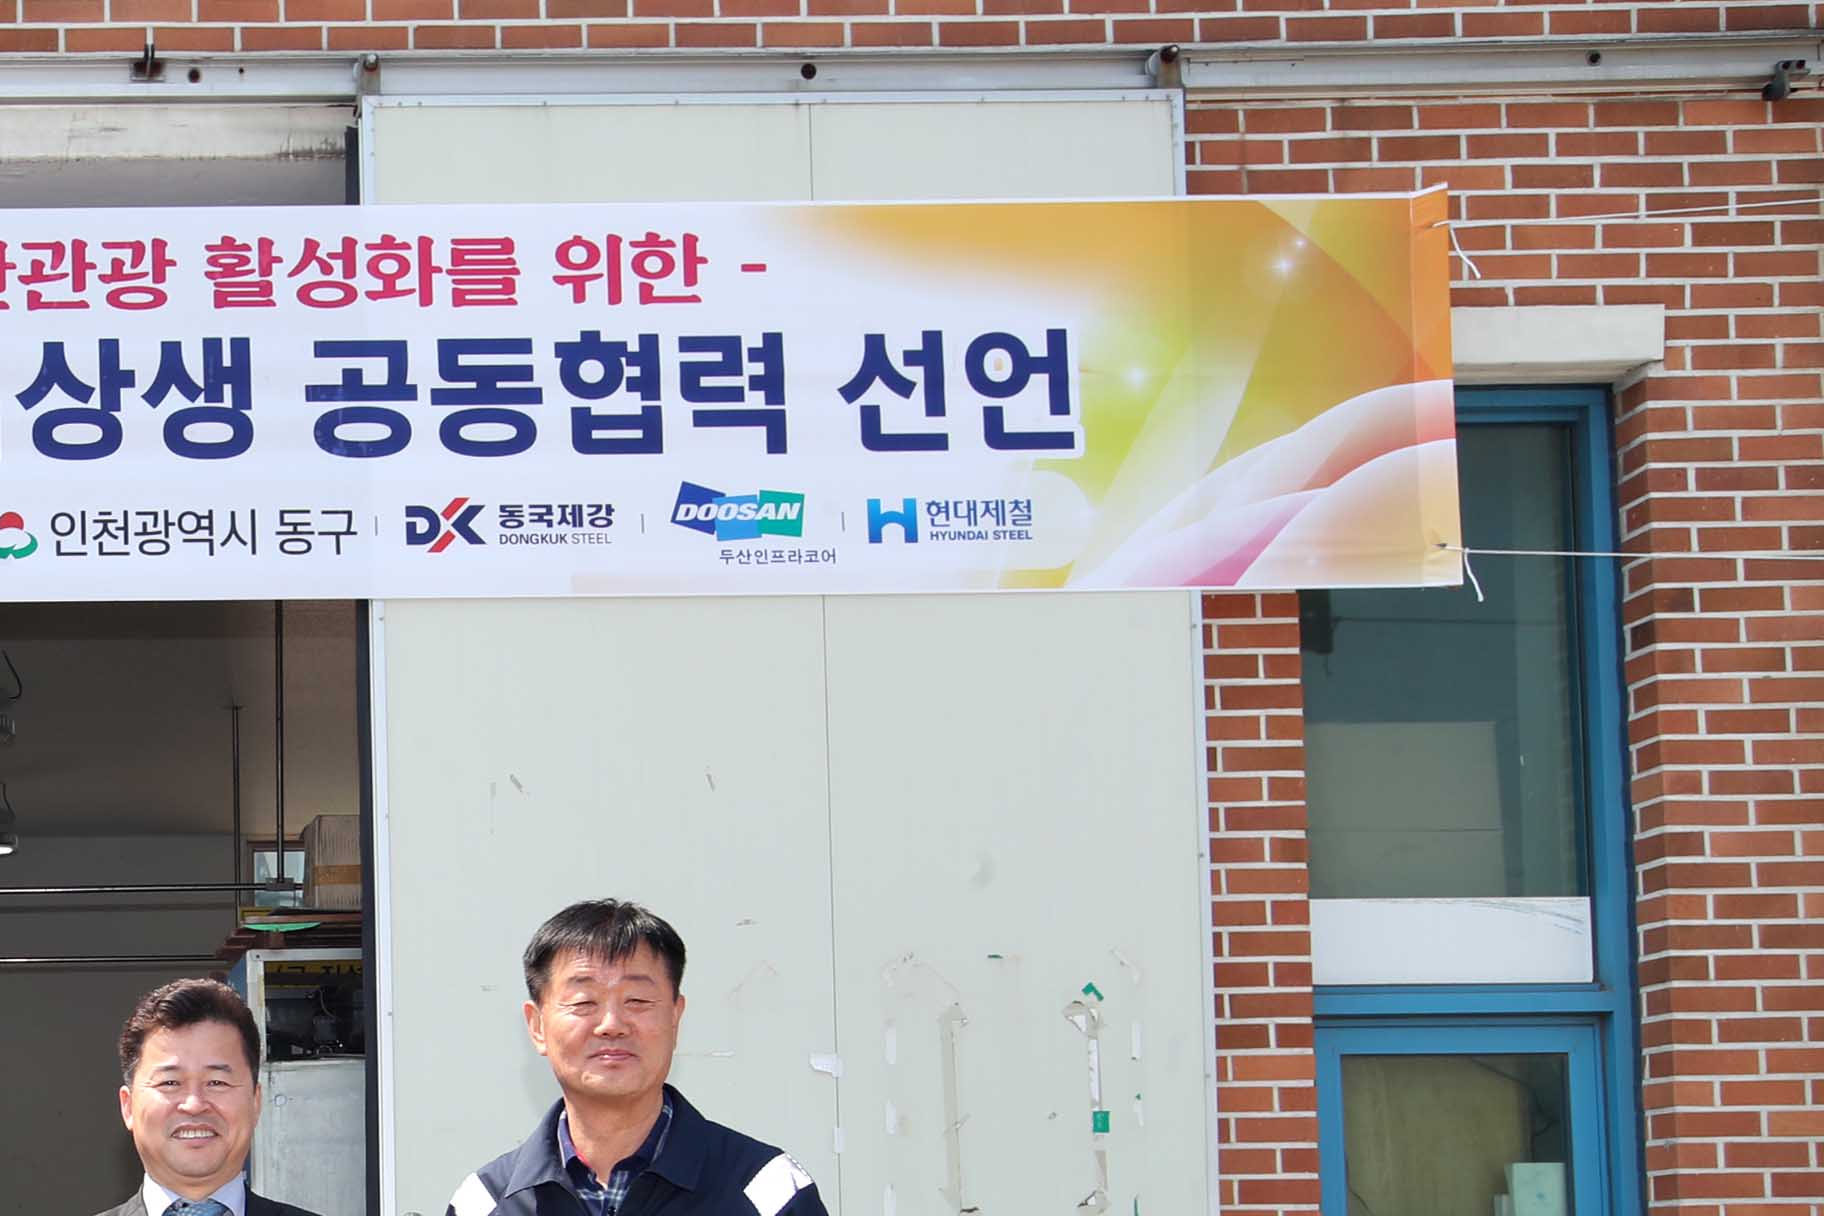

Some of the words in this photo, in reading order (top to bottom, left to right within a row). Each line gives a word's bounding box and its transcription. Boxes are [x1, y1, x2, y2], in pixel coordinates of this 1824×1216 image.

[203, 233, 521, 310] 활성화를
[551, 231, 709, 306] 위한
[304, 329, 788, 459] 공동협력
[836, 327, 1078, 453] 선언
[498, 503, 616, 530] 동국제강
[674, 502, 801, 521] DOOSAN
[926, 498, 1033, 528] 현대제철
[50, 508, 257, 557] 인천광역시
[274, 508, 359, 556] 동구
[499, 533, 568, 545] DONGKUK
[571, 532, 611, 545] STEEL
[929, 530, 989, 541] HYUNDAI
[992, 530, 1033, 541] STEEL
[719, 548, 837, 565] 두산인프라코어
